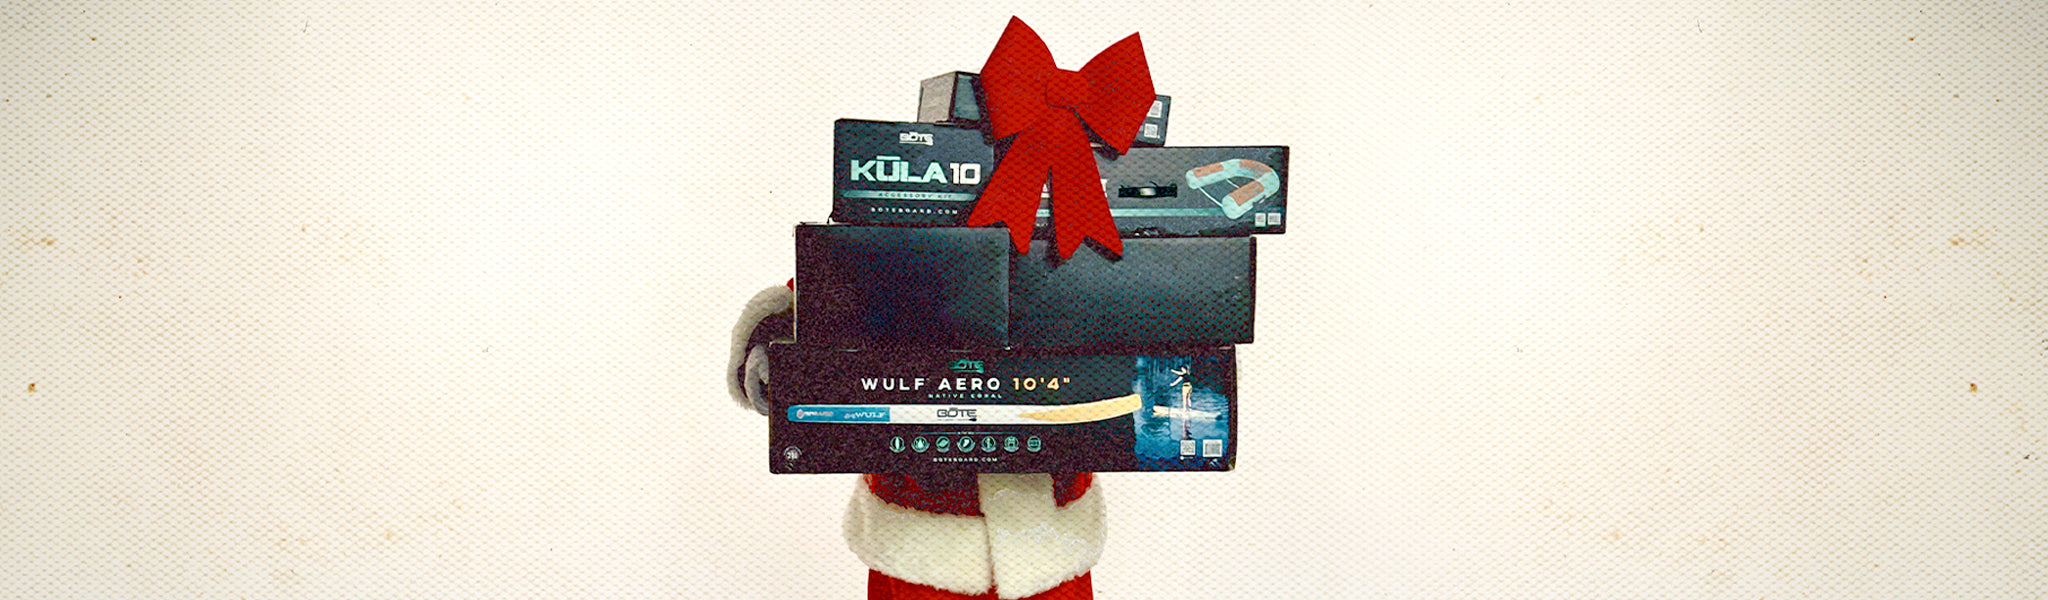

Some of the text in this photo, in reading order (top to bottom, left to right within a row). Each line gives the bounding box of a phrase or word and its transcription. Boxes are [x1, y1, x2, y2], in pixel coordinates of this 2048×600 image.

[949, 162, 981, 185] 10
[871, 207, 958, 215] BOTEBOARD.COM
[861, 377, 1071, 391] WULF AERO 10'4"
